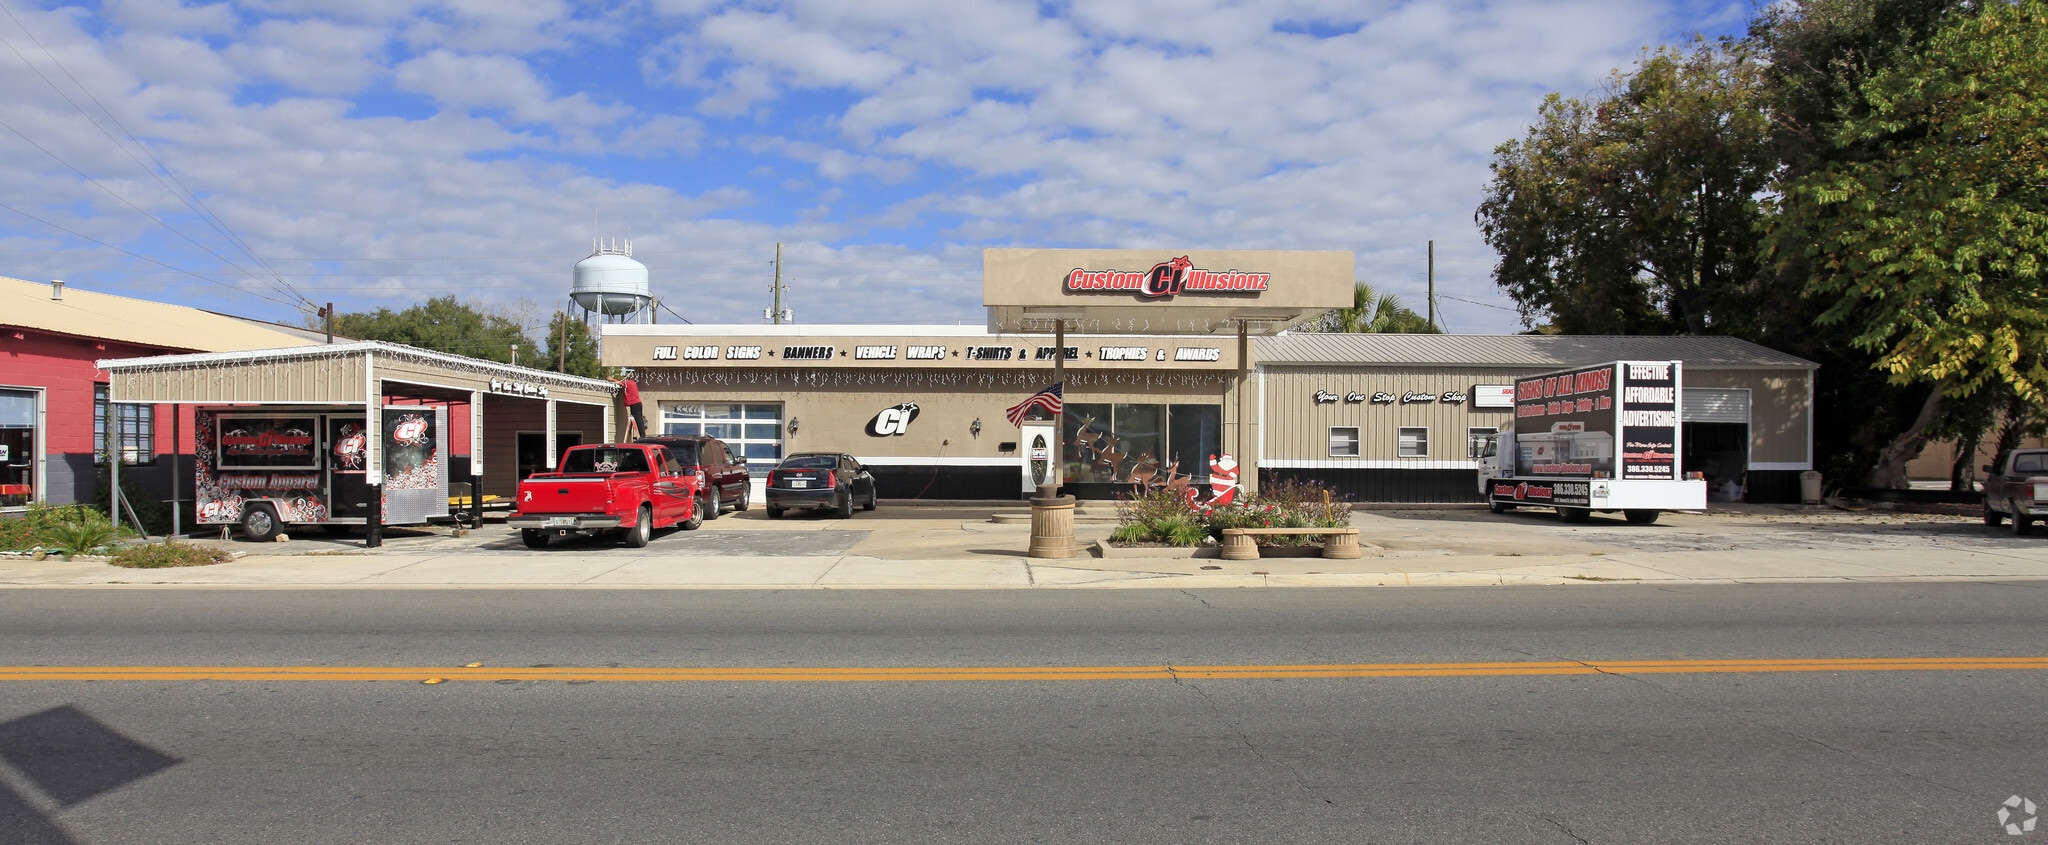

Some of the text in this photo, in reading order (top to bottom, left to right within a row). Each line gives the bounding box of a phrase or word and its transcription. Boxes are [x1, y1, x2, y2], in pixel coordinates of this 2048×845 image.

[1068, 268, 1145, 291] Custom
[1185, 269, 1271, 292] Illusionz
[653, 345, 1221, 362] FULL COLOR SIGNS BANNERS VEHICLE WRAPS T-SHIRTS & APPREL TROPHIES & AWARDS
[1630, 365, 1669, 380] EFFECTIVE
[1517, 368, 1611, 401] SIGNS OF ALL KINDS!
[1316, 390, 1468, 403] Your One Stop Custom Shop
[1625, 386, 1674, 403] AFFORDABLE
[1623, 411, 1675, 427] ADVERTISING
[1627, 465, 1670, 473] 386.330.5245
[218, 474, 320, 490] Custom Apparel
